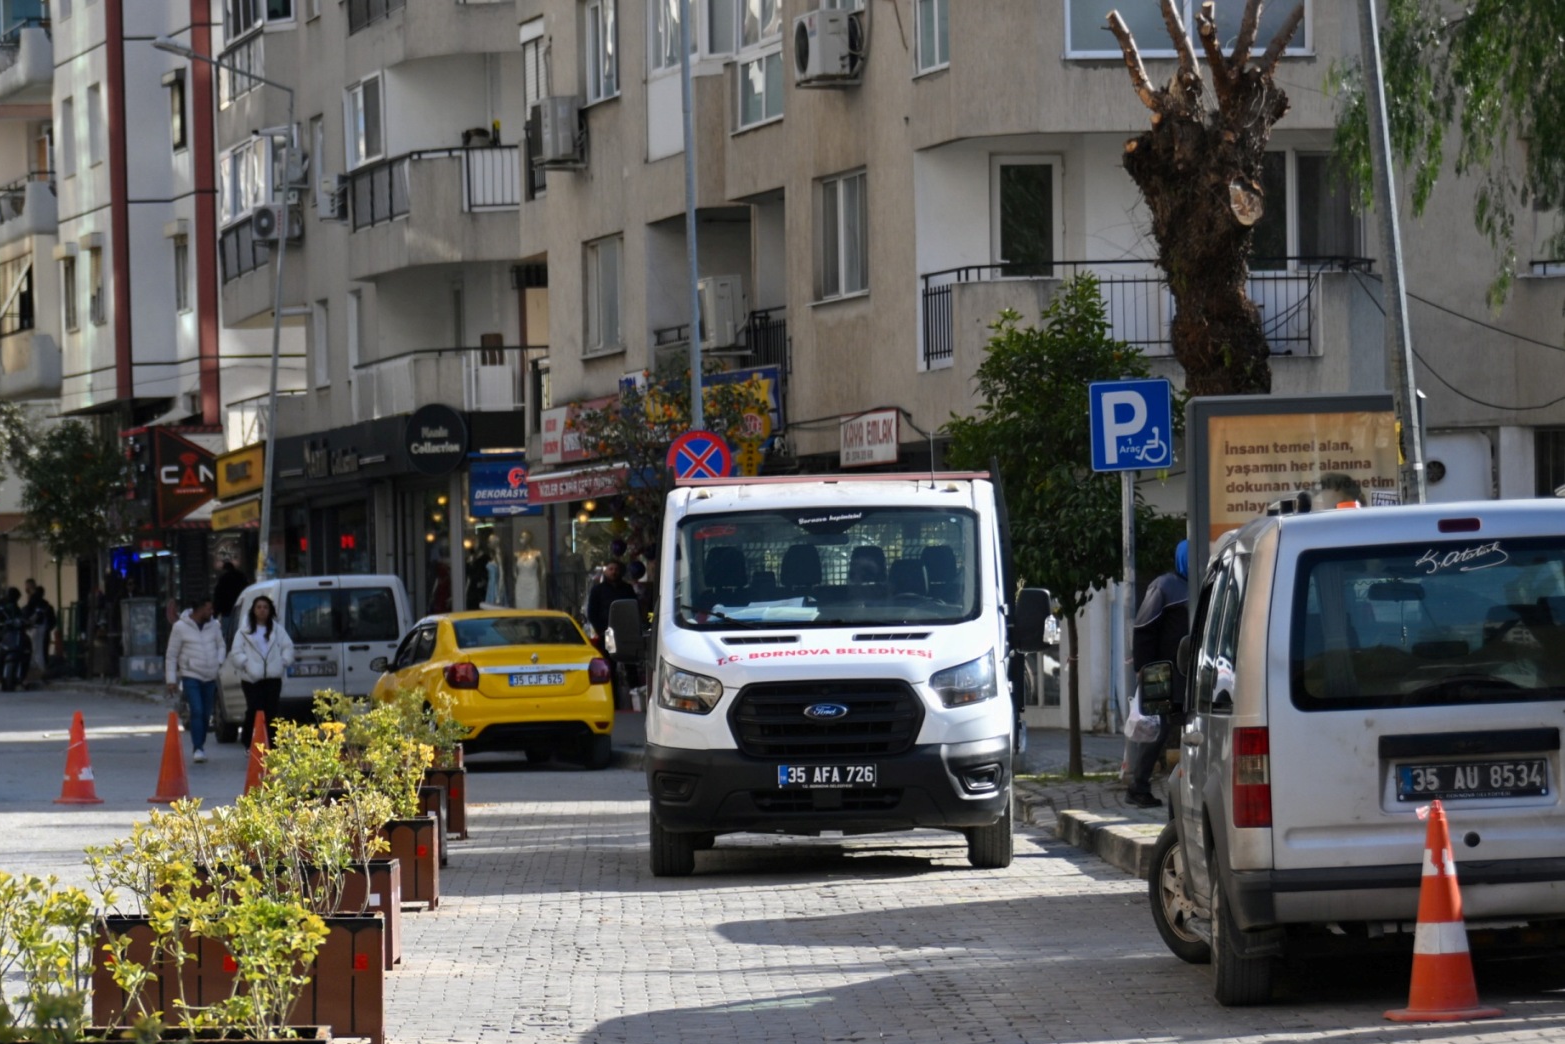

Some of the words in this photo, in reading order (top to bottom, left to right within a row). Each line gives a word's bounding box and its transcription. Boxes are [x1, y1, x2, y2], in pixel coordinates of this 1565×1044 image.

[843, 421, 864, 448] KAYA
[866, 418, 894, 446] EMLAK
[1101, 390, 1147, 465] P
[1119, 446, 1141, 455] Araç
[1225, 441, 1269, 455] İnsanı
[1273, 441, 1315, 453] temel
[1319, 440, 1354, 454] alan,
[1226, 462, 1285, 477] yaşamın
[1290, 460, 1314, 472] her
[1319, 459, 1372, 471] alanına
[1226, 481, 1290, 494] dokunan
[716, 655, 743, 666] T.C.
[749, 648, 830, 660] BORNOVA
[836, 646, 932, 660] BELEDİYESİ
[514, 675, 524, 685] 35
[528, 675, 543, 685] CJF
[547, 674, 563, 684] 625
[788, 767, 806, 783] 35
[813, 767, 840, 783] AFA
[846, 766, 873, 782] 726
[1413, 768, 1439, 791] 35
[1454, 766, 1478, 789] AU
[1490, 764, 1541, 787] 8534
